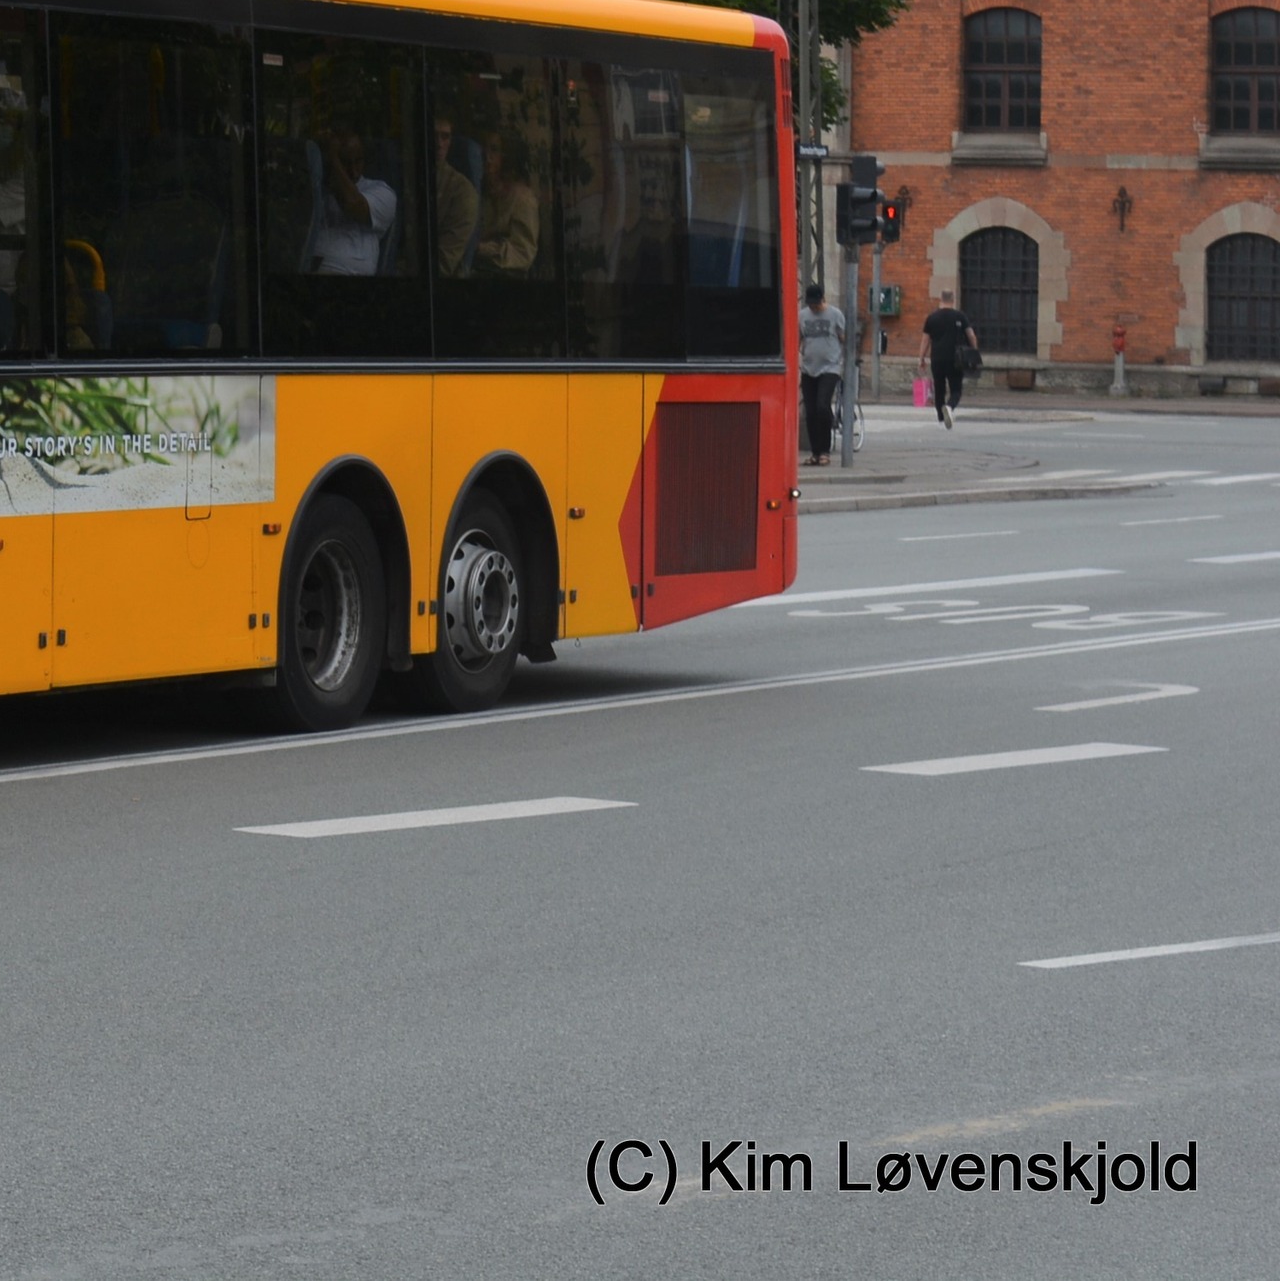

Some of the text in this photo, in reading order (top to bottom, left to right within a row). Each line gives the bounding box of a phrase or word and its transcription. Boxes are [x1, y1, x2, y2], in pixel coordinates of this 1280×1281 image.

[24, 434, 92, 458] STORY'S
[99, 435, 116, 454] IN
[123, 433, 151, 454] THE
[158, 432, 212, 453] DETAIL
